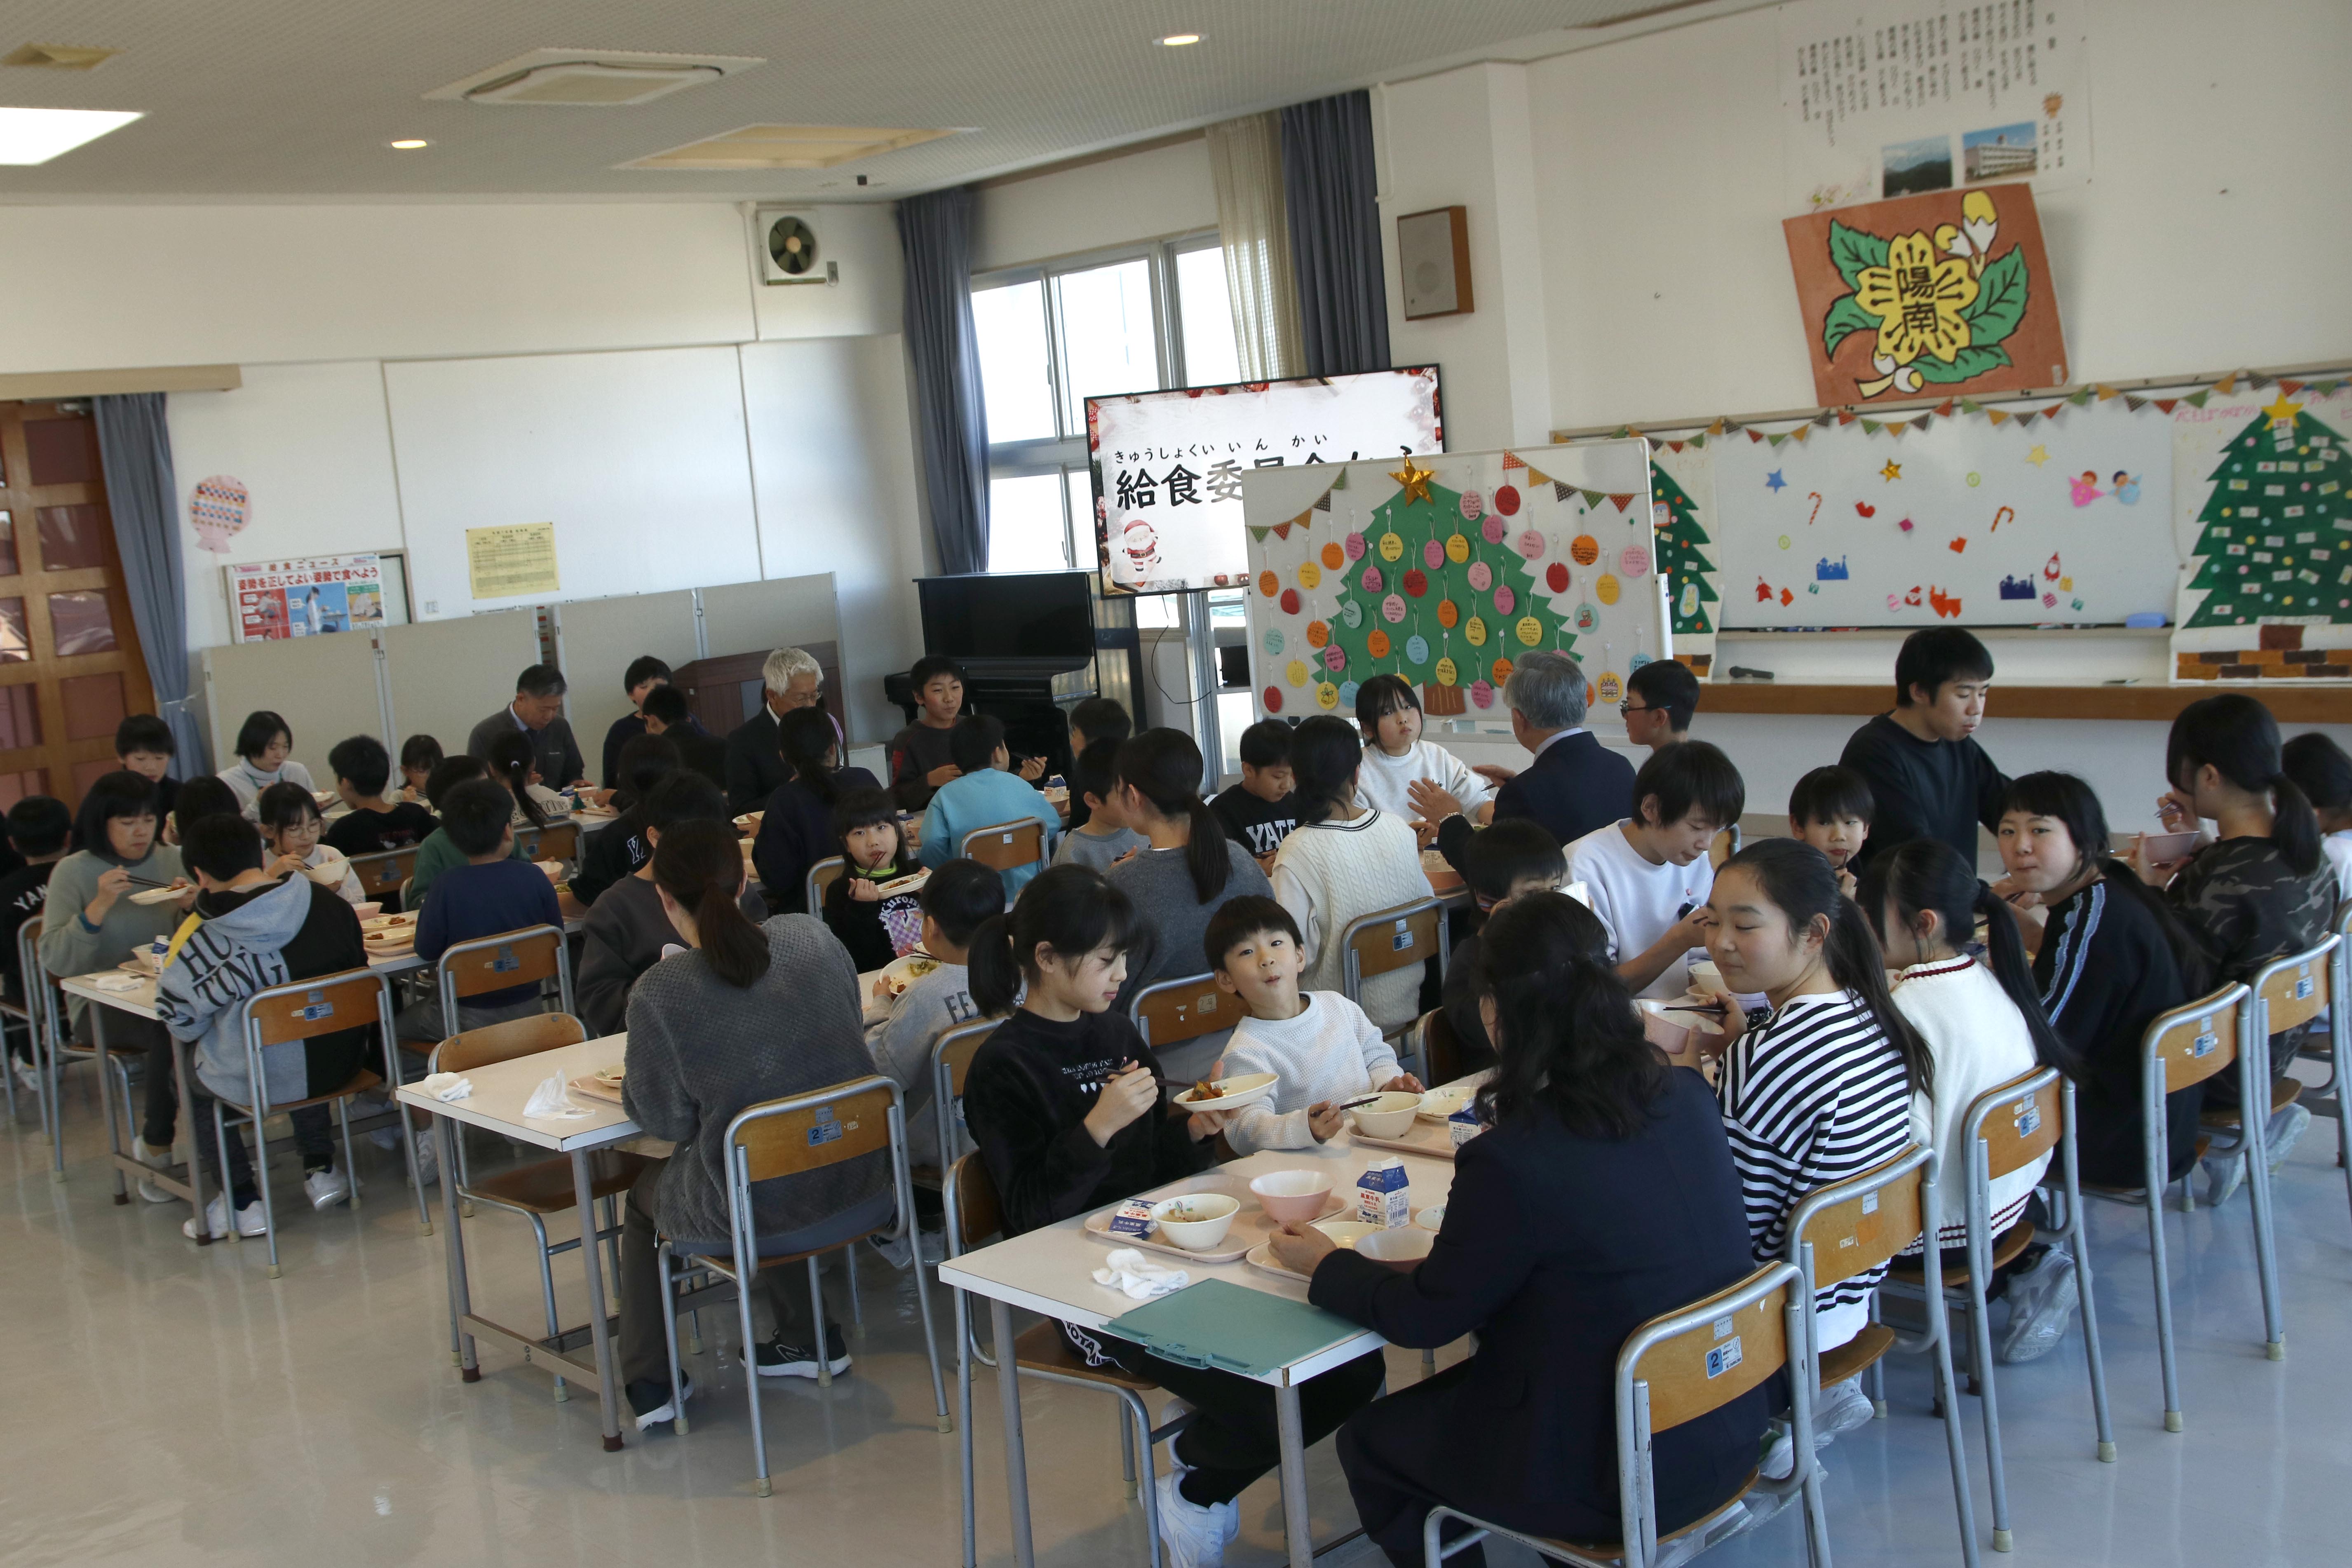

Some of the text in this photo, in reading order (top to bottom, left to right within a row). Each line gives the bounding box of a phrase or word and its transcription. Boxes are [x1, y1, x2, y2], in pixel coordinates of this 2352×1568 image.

[1896, 266, 1939, 333] 陽南
[238, 567, 378, 590] 姿勢を正してよい姿勢で食べよう
[880, 896, 920, 918] Kurom
[177, 924, 246, 982] HU
[812, 1129, 819, 1140] 2
[2022, 1118, 2027, 1130] 2
[1711, 1352, 1719, 1368] 2
